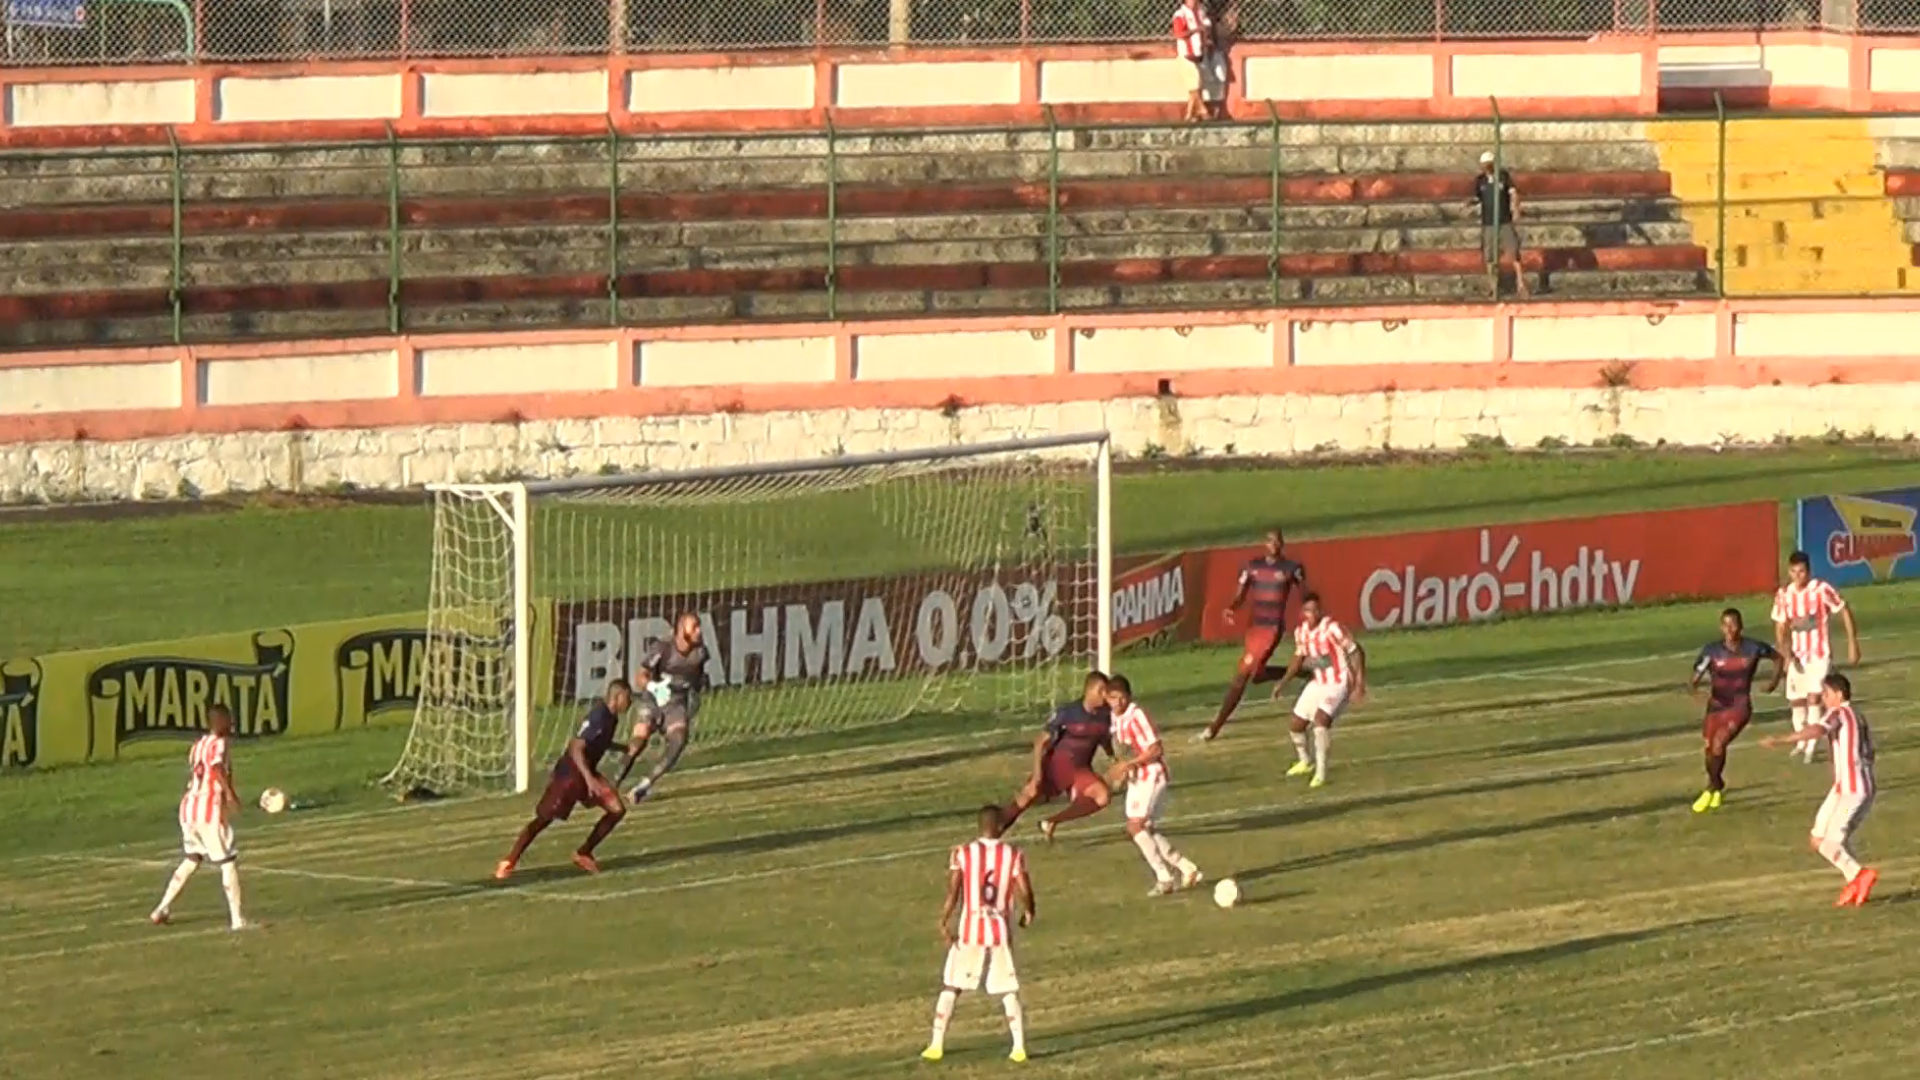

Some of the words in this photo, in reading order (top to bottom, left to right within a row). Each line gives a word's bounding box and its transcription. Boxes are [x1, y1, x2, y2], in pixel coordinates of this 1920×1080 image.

[917, 580, 1067, 669] 0.0%
[1112, 566, 1184, 631] RAHMA
[982, 870, 998, 905] 6
